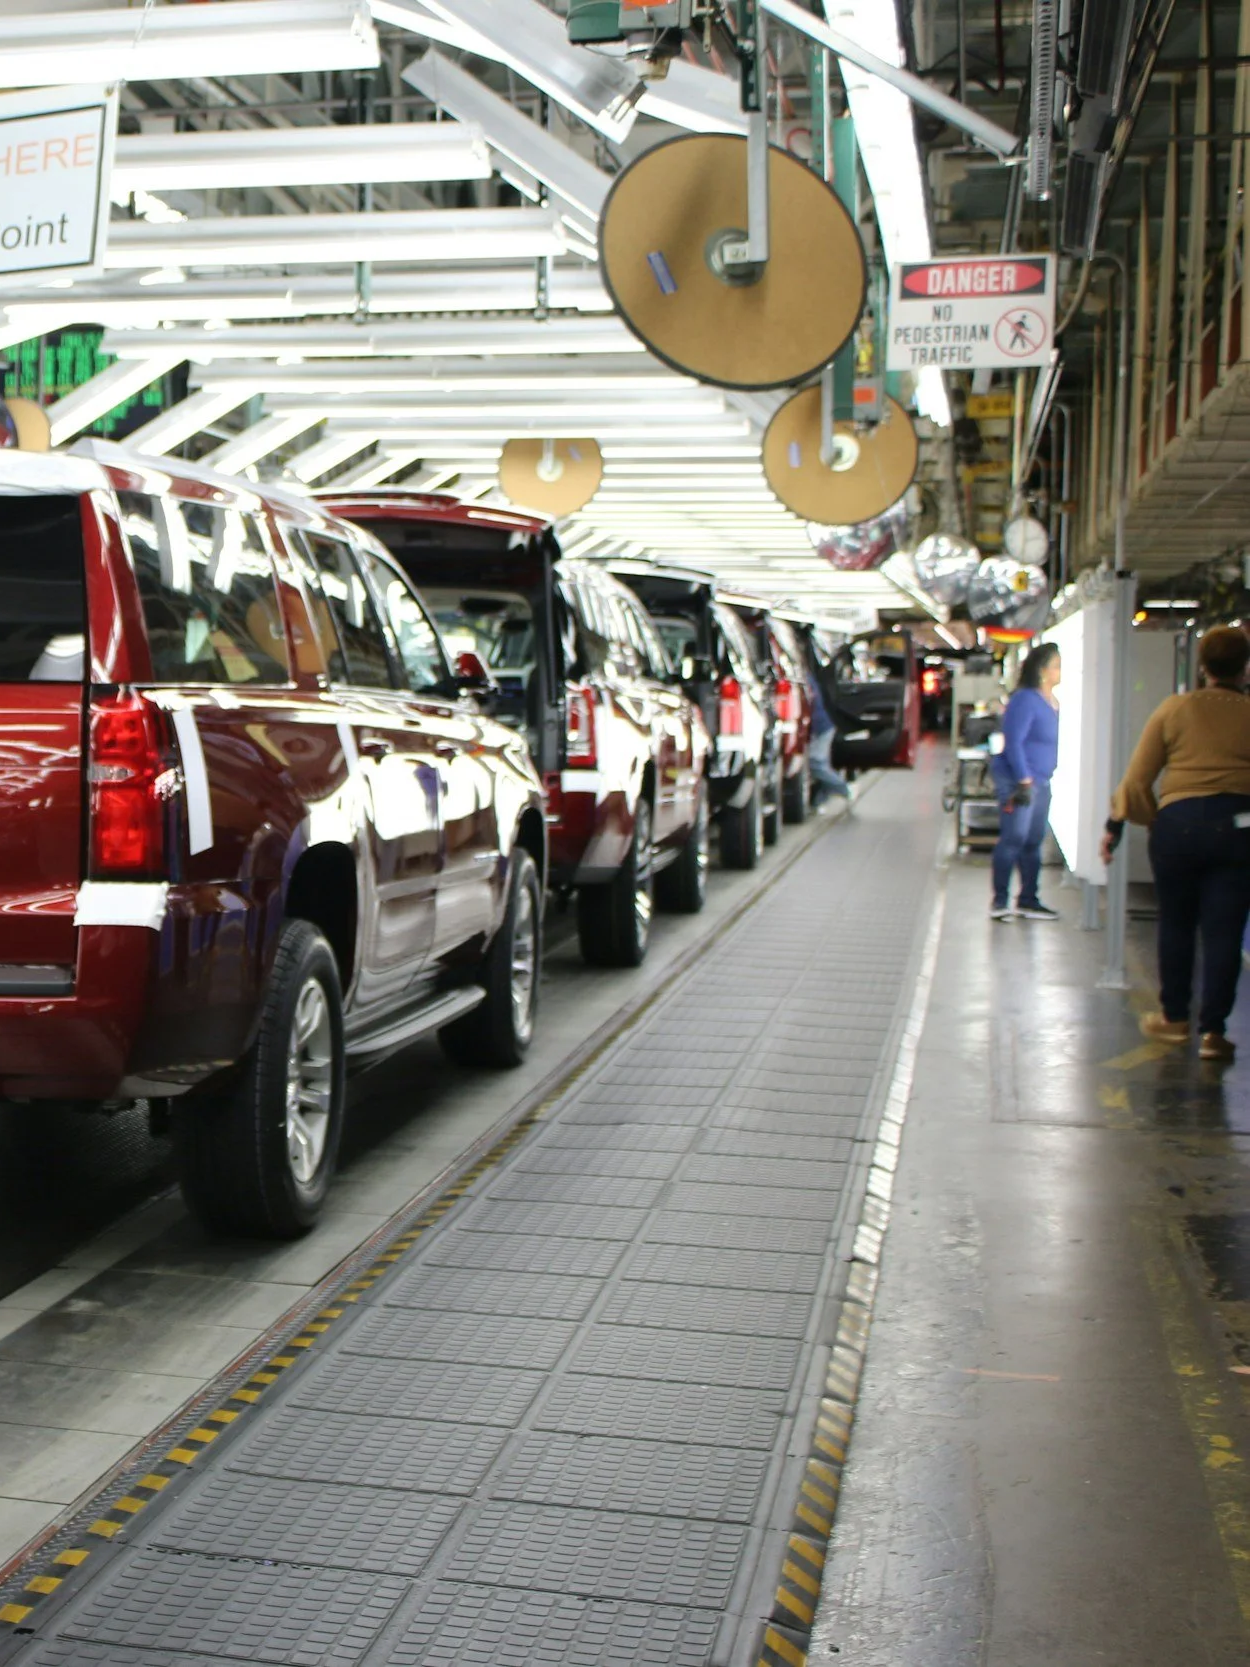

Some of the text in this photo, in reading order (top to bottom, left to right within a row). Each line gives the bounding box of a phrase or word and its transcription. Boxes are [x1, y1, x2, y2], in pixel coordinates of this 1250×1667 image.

[927, 263, 1017, 295] DANGER
[932, 304, 953, 322] NO
[894, 324, 990, 344] PEDESTRIAN
[908, 346, 973, 365] TRAFFIC
